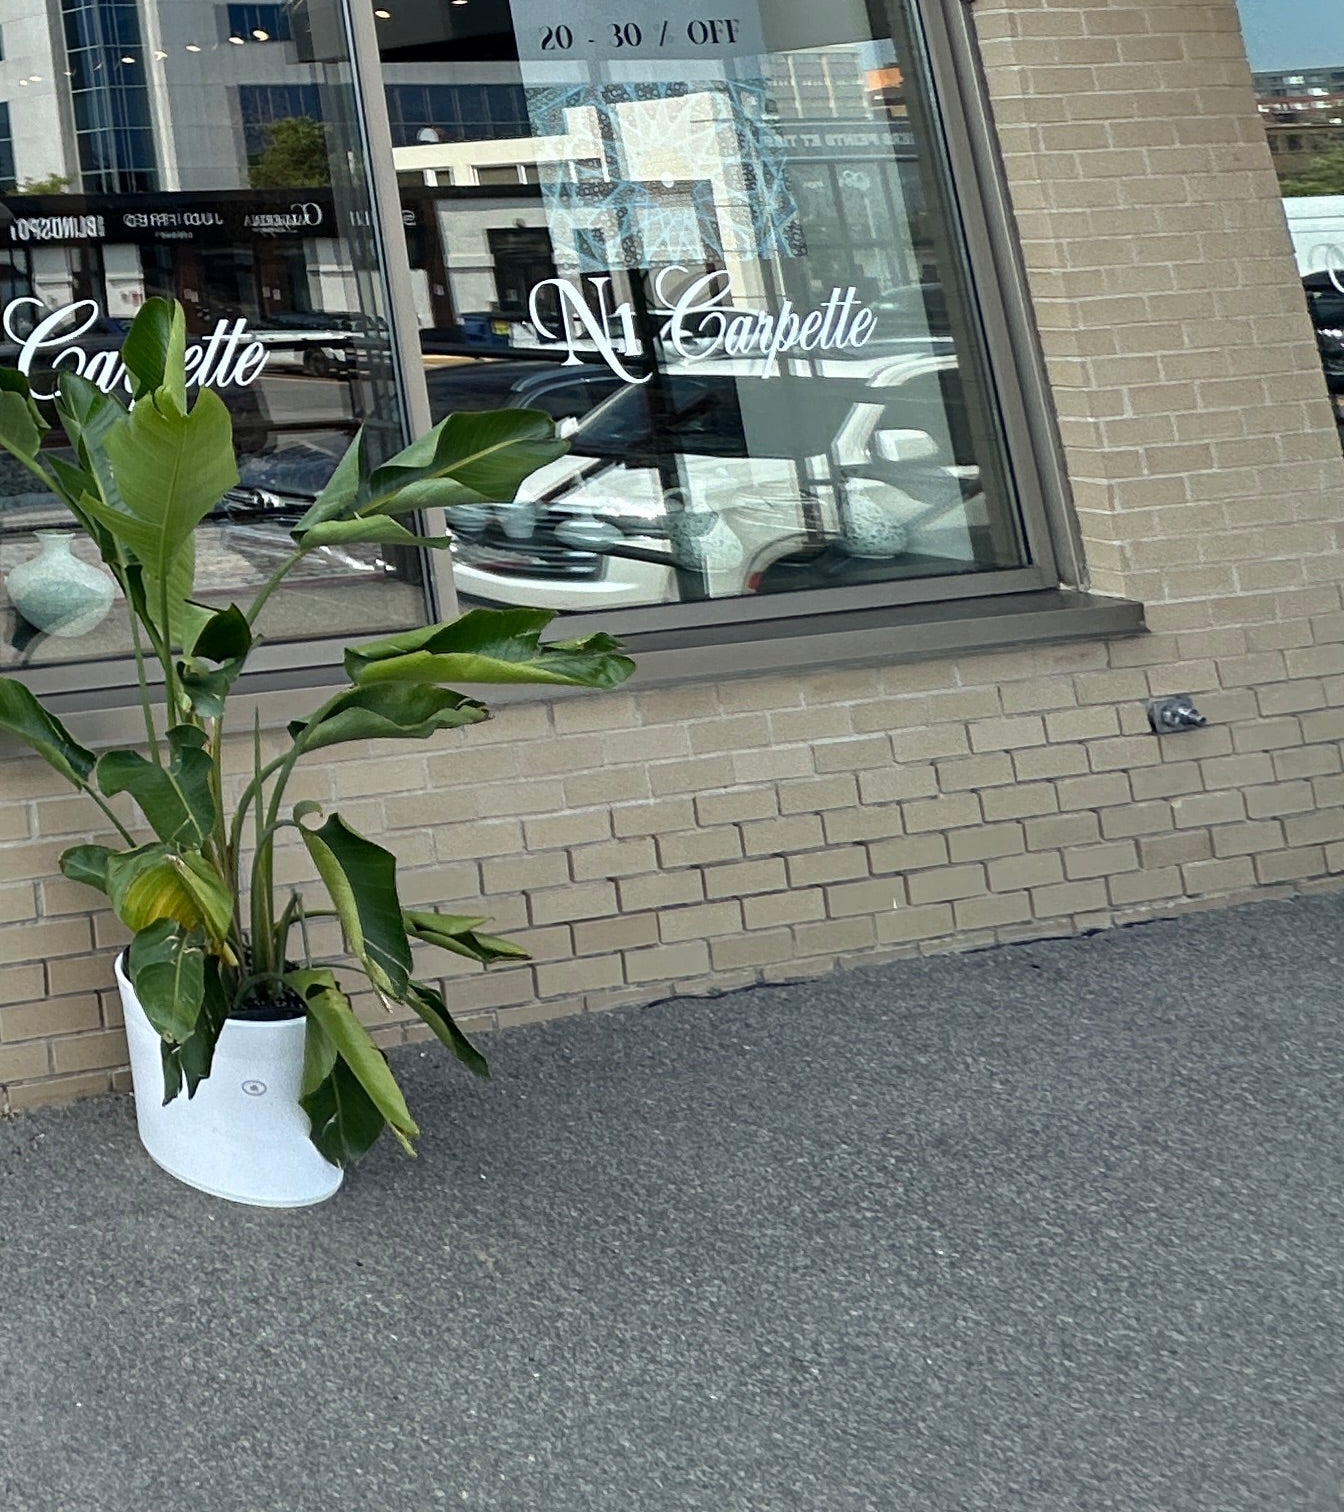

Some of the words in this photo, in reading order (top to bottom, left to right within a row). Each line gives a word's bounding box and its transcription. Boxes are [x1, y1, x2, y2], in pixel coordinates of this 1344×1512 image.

[539, 24, 574, 50] 20
[607, 22, 642, 48] 30
[686, 19, 740, 45] OFF
[2, 296, 270, 412] Caette
[654, 265, 879, 379] Carpette
